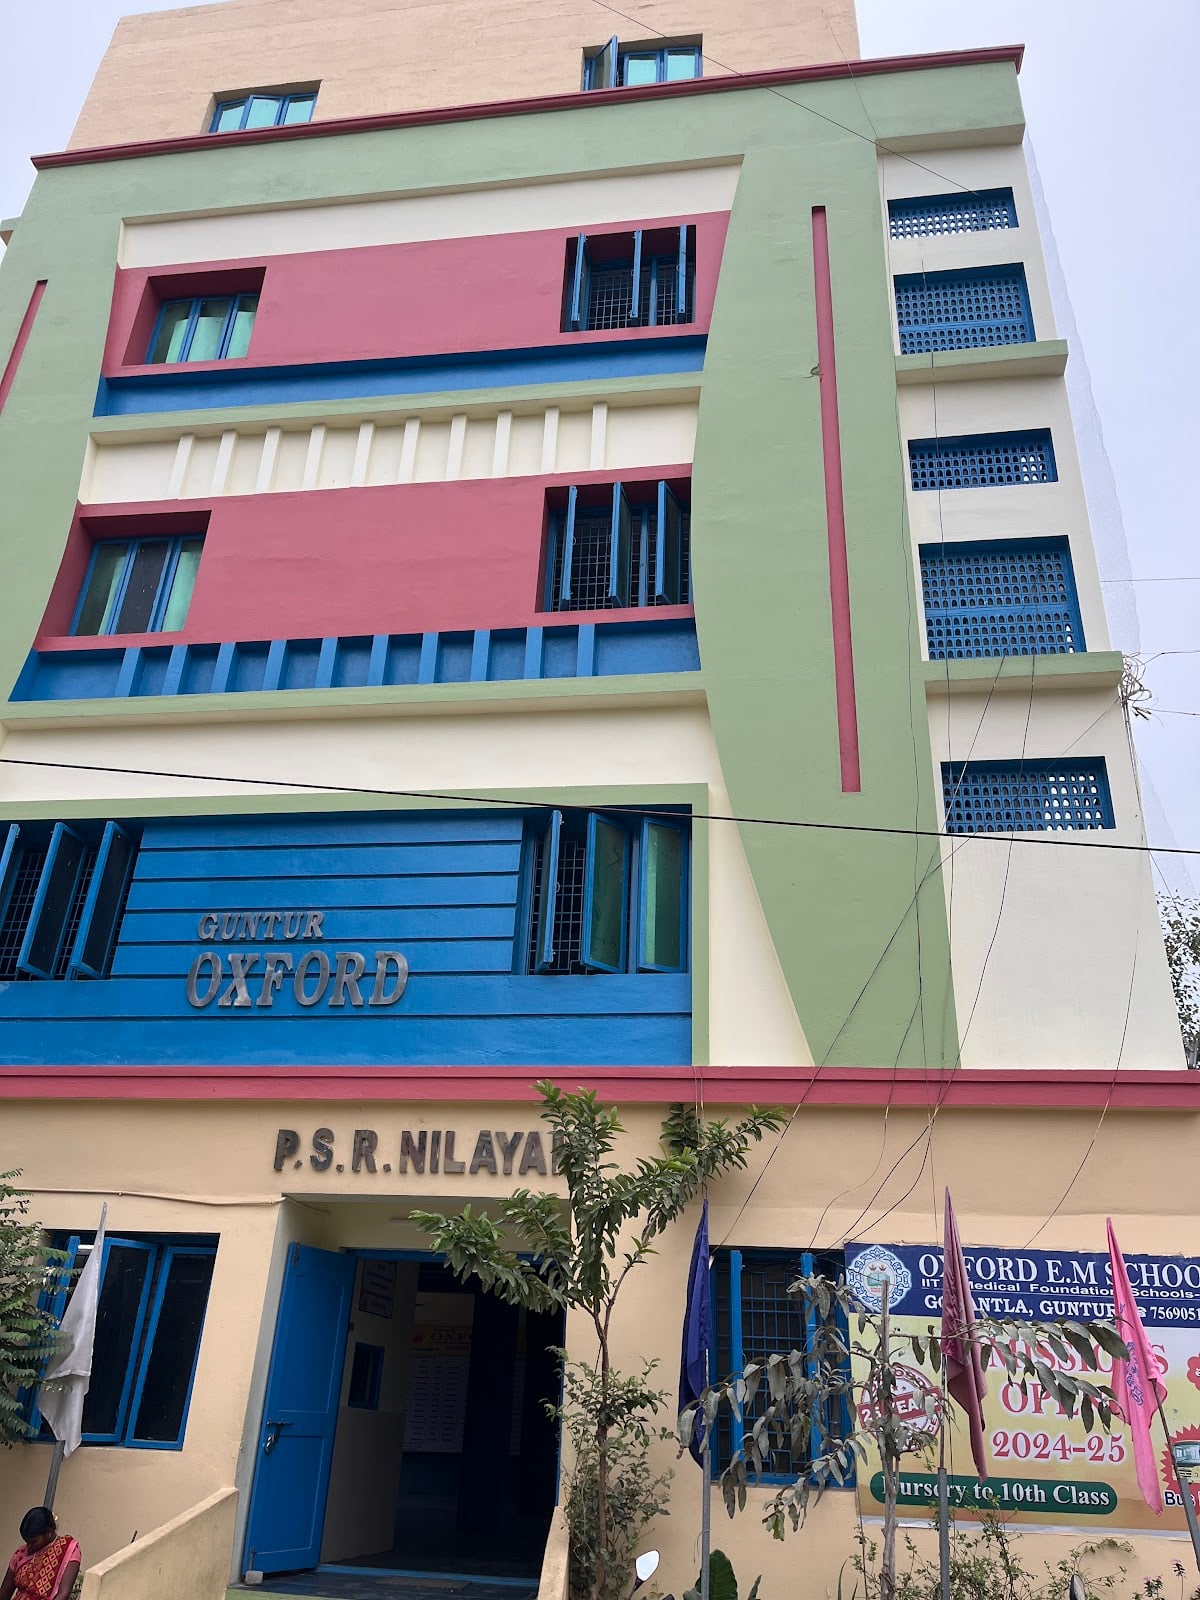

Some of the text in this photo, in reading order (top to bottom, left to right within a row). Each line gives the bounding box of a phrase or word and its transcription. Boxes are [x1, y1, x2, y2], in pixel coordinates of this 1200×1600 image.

[198, 911, 324, 940] GUNTUR
[186, 950, 409, 1008] OXFORD
[919, 1253, 1038, 1282] OFORD
[1045, 1259, 1098, 1285] E.M
[922, 1278, 940, 1288] IIT
[924, 1294, 1033, 1317] GANTLA,
[992, 1431, 1126, 1463] 2024-25
[973, 1482, 994, 1500] to
[1000, 1482, 1047, 1503] 10th
[1053, 1485, 1110, 1506] Class
